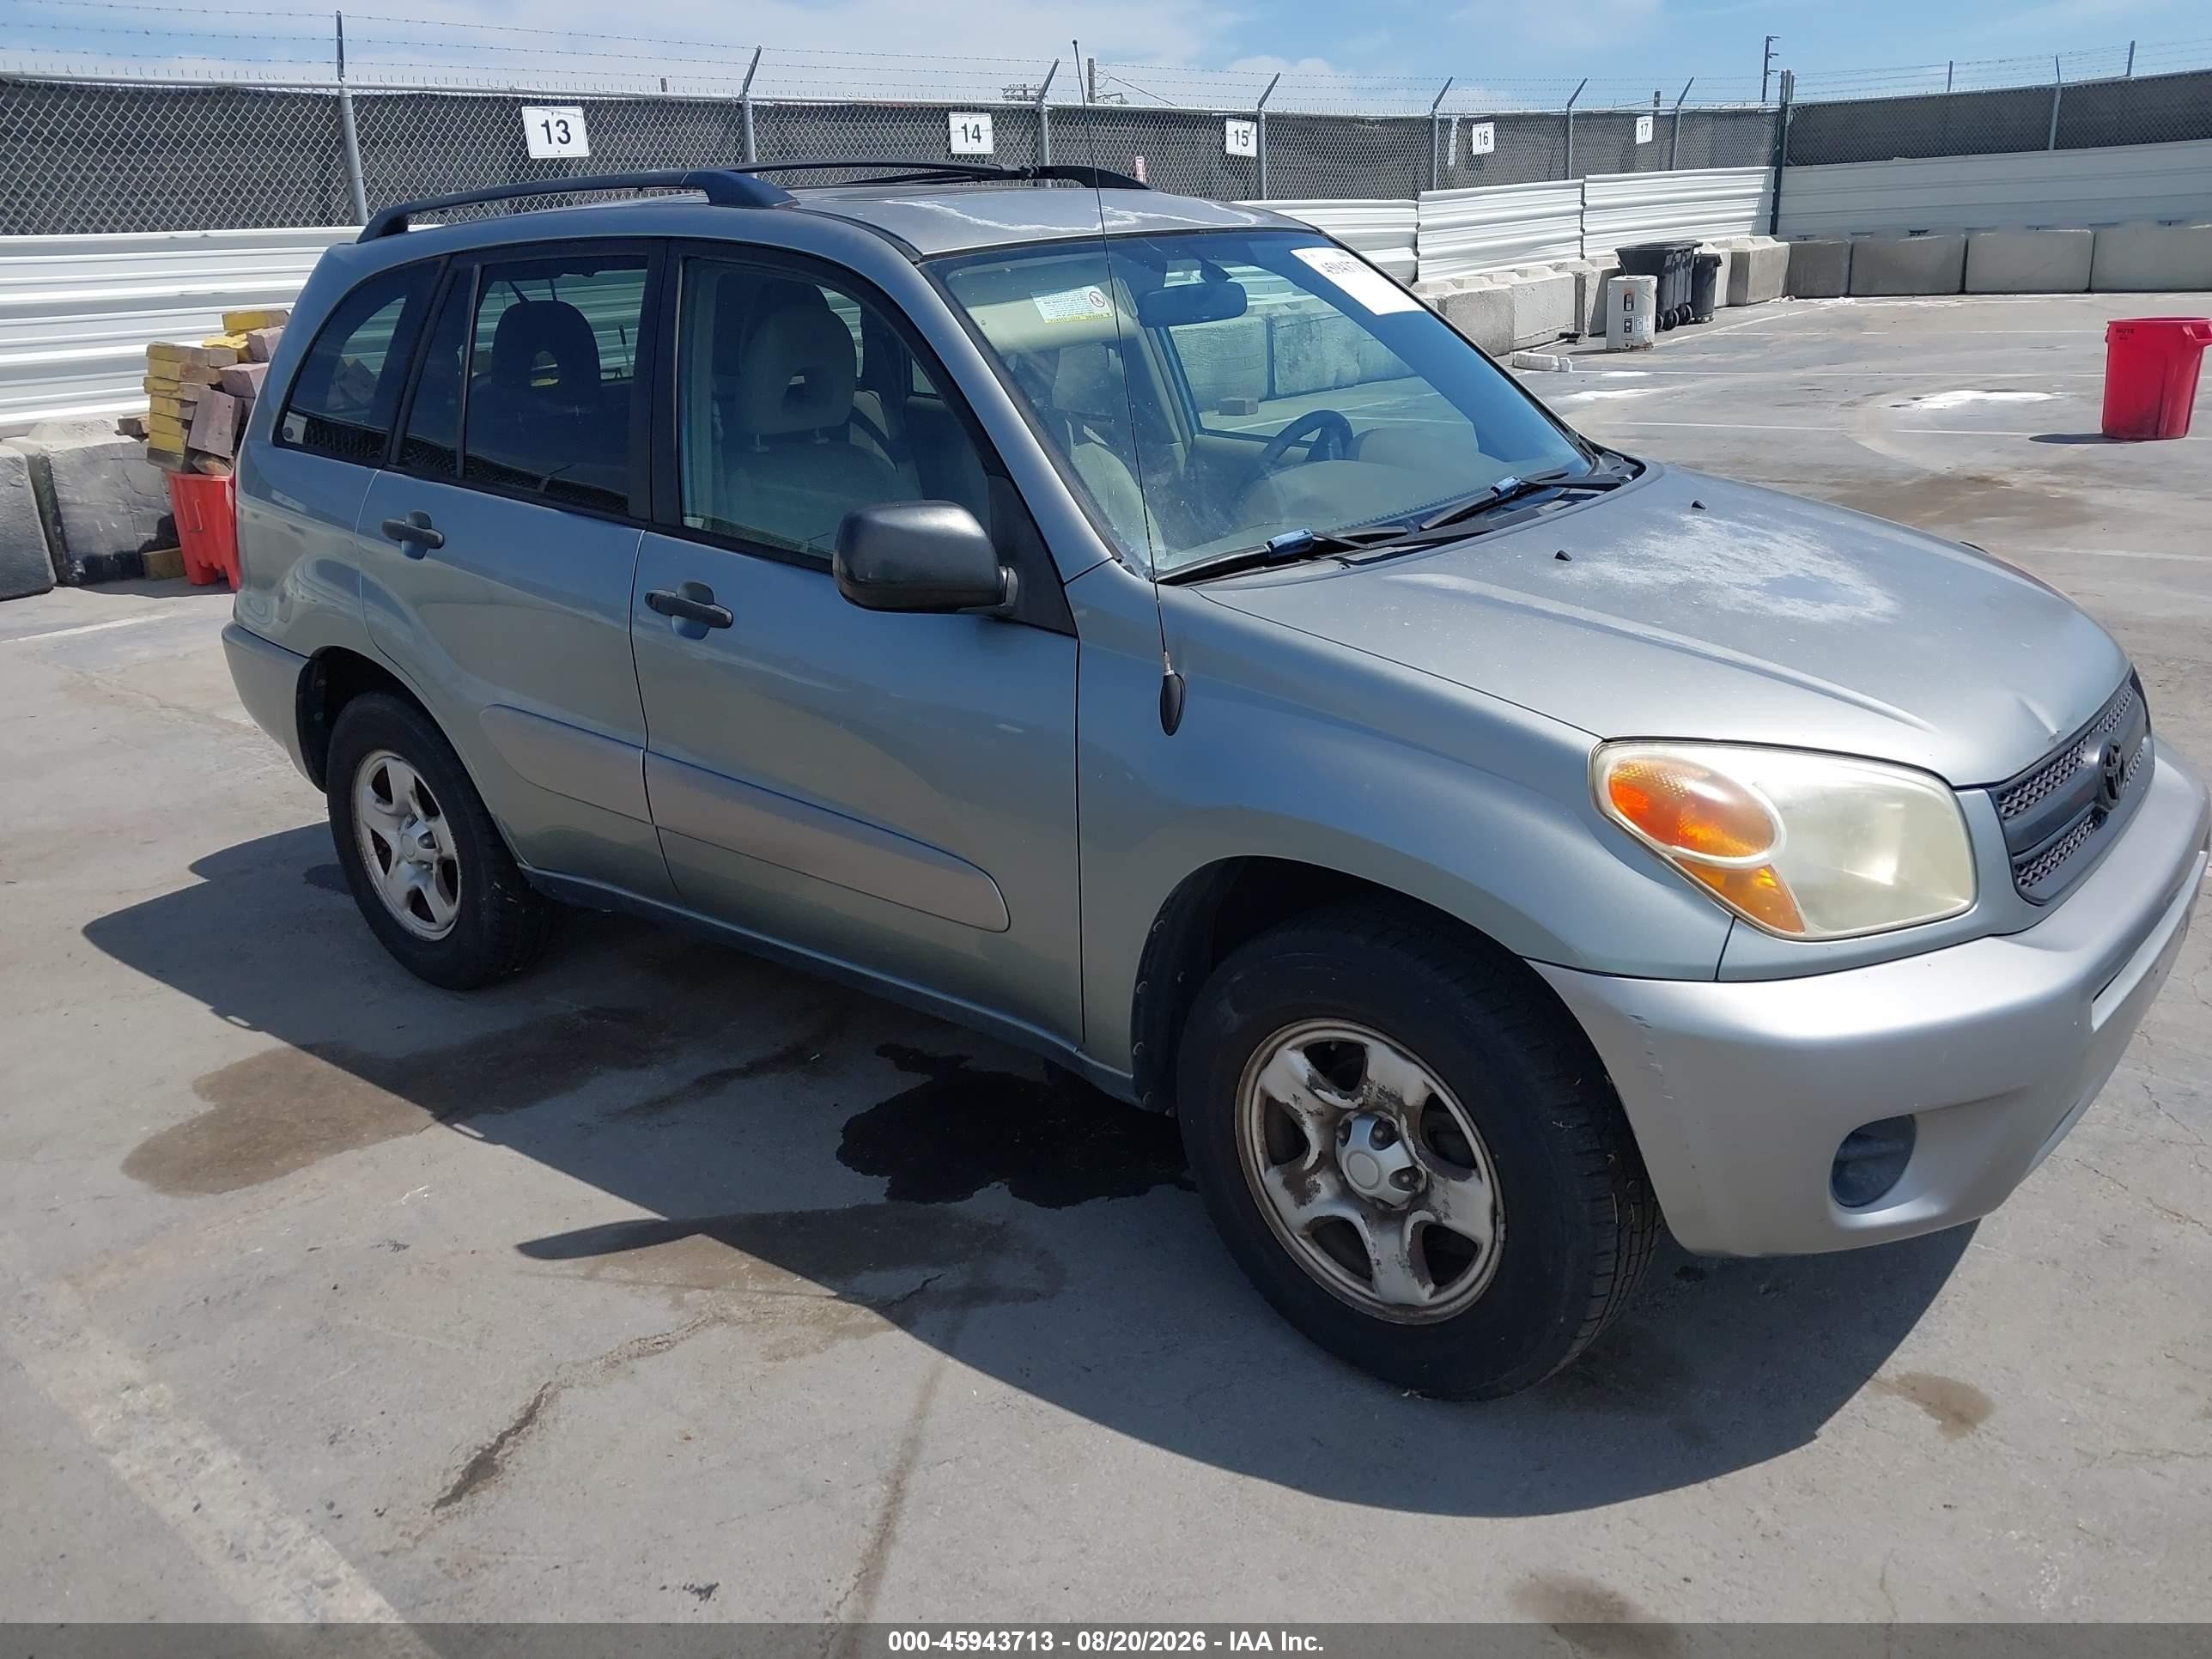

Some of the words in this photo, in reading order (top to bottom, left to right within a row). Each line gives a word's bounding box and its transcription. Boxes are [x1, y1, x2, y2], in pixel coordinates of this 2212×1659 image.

[540, 119, 571, 145] 13
[961, 124, 981, 143] 14
[1234, 130, 1249, 147] 15
[1479, 131, 1489, 146] 16
[1641, 123, 1649, 137] 17
